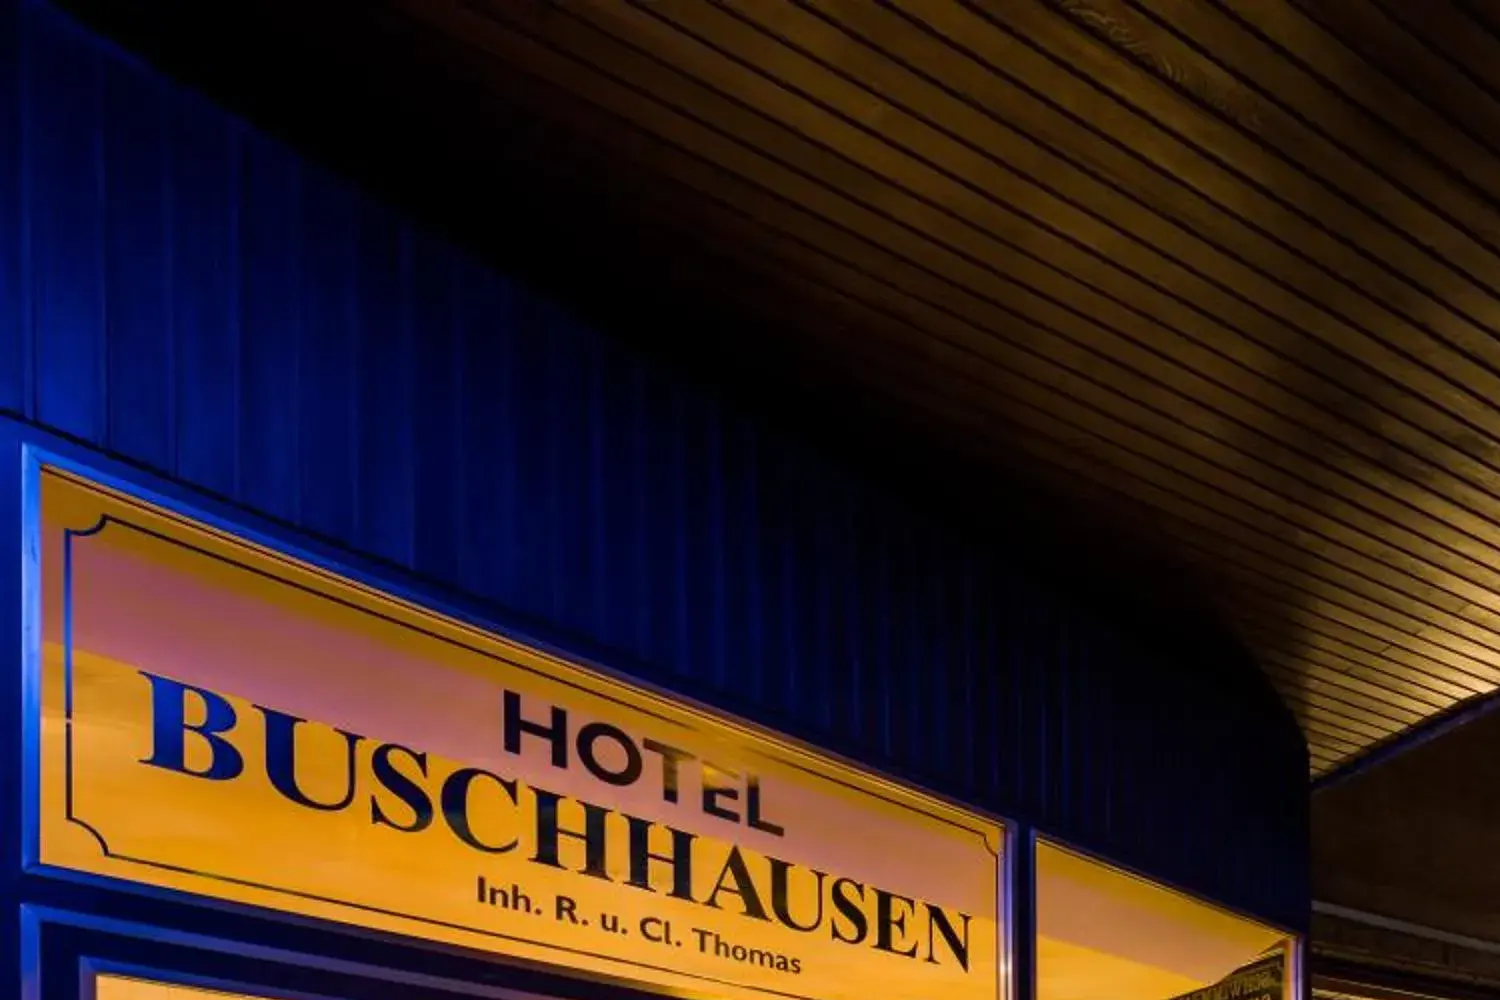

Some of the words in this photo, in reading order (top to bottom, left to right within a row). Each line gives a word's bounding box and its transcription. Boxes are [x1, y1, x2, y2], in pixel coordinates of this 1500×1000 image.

[137, 669, 973, 974] BUSCHHAUSEN
[503, 690, 785, 837] HOTEL
[477, 875, 543, 916] Inh.
[555, 894, 589, 926] R.
[601, 912, 629, 936] u.
[639, 915, 683, 947] Cl.
[691, 926, 801, 974] Thomas
